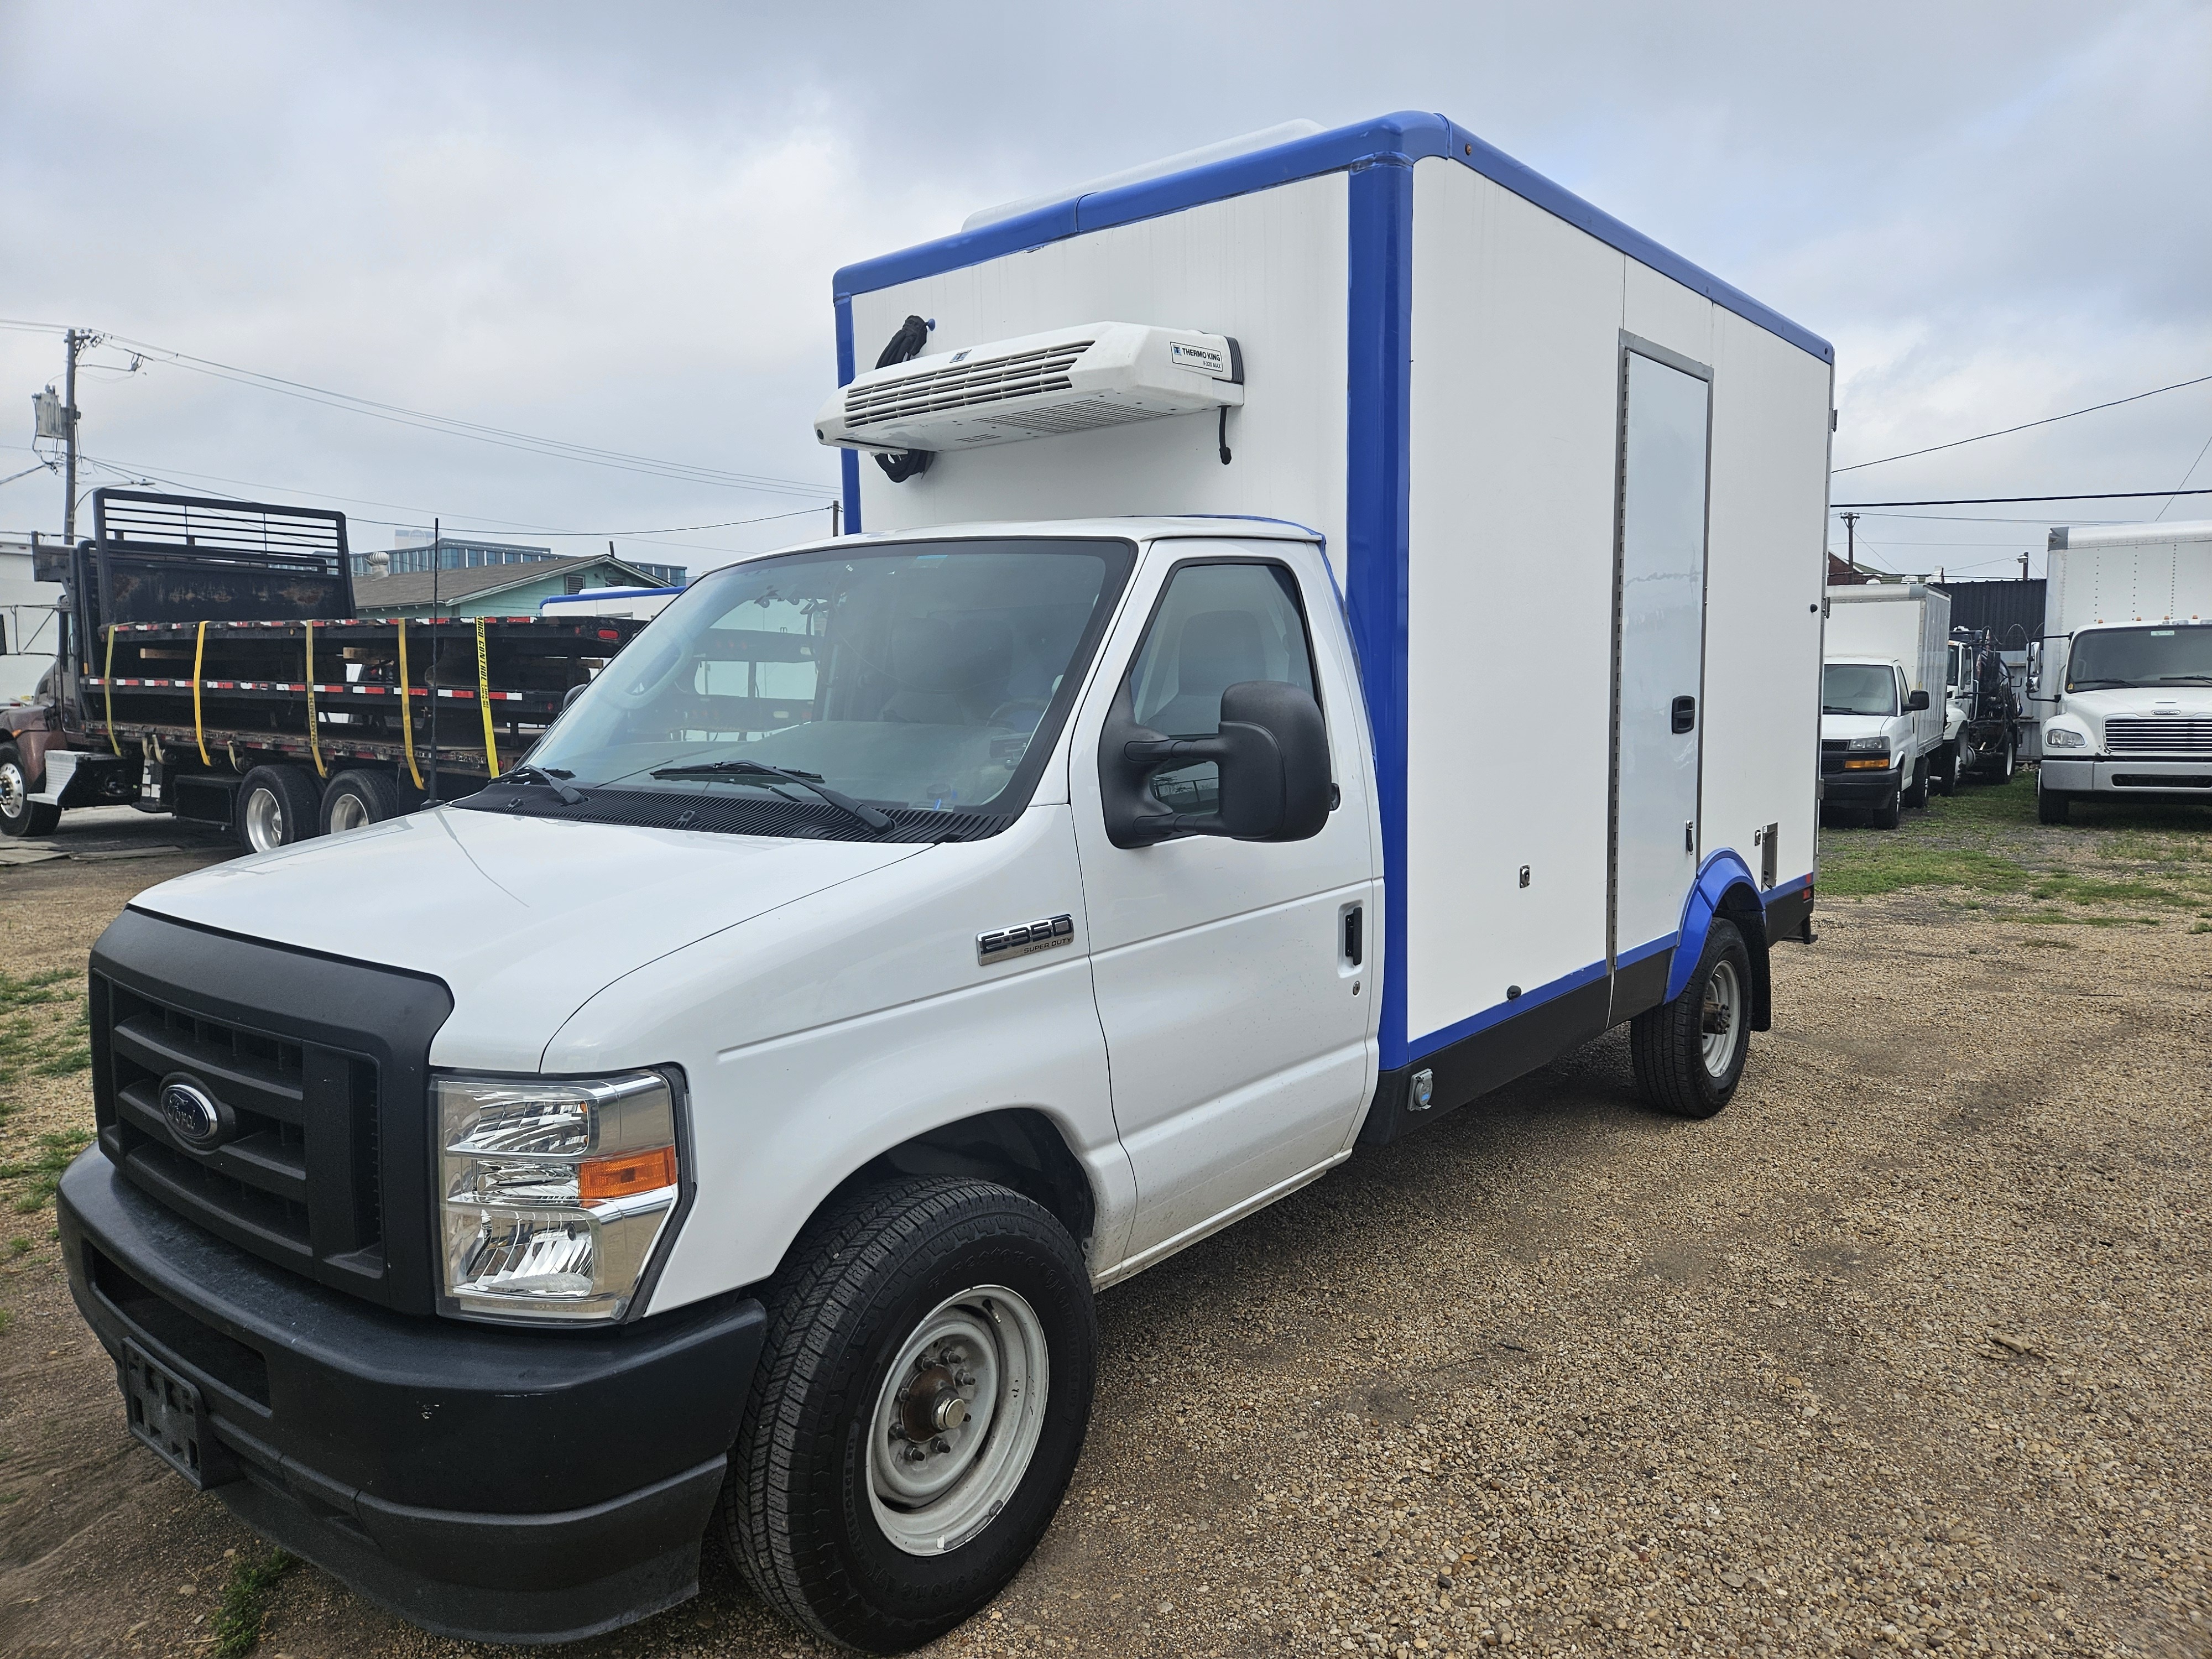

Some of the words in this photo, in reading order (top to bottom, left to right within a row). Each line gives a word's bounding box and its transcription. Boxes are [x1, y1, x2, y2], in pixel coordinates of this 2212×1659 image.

[1182, 348, 1207, 359] THERMO
[1207, 352, 1220, 361] KING
[478, 640, 487, 681] CONTROL
[981, 916, 1073, 954] E-350
[1024, 942, 1050, 953] SUPER
[1051, 937, 1072, 946] DUTY
[168, 1093, 196, 1130] Ford
[900, 1532, 1017, 1600] Firestone
